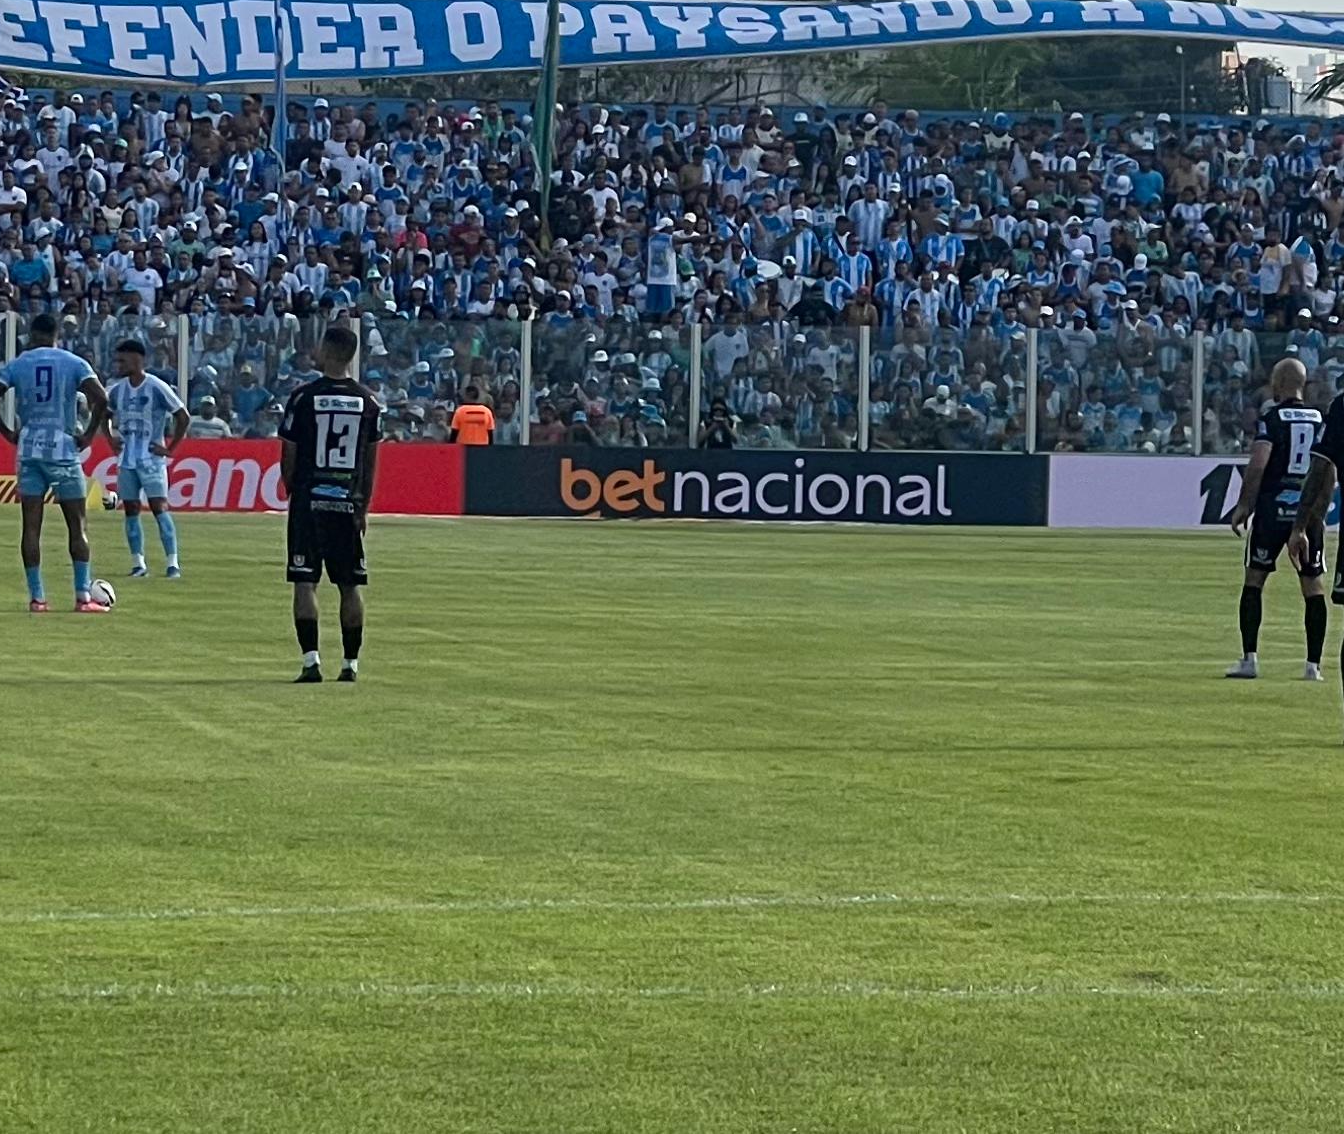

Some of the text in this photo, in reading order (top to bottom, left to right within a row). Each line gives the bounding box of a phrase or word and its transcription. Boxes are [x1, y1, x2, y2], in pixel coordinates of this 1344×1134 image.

[445, 1, 502, 63] O
[35, 366, 52, 403] 9
[316, 413, 362, 468] 13
[1287, 423, 1314, 474] 8
